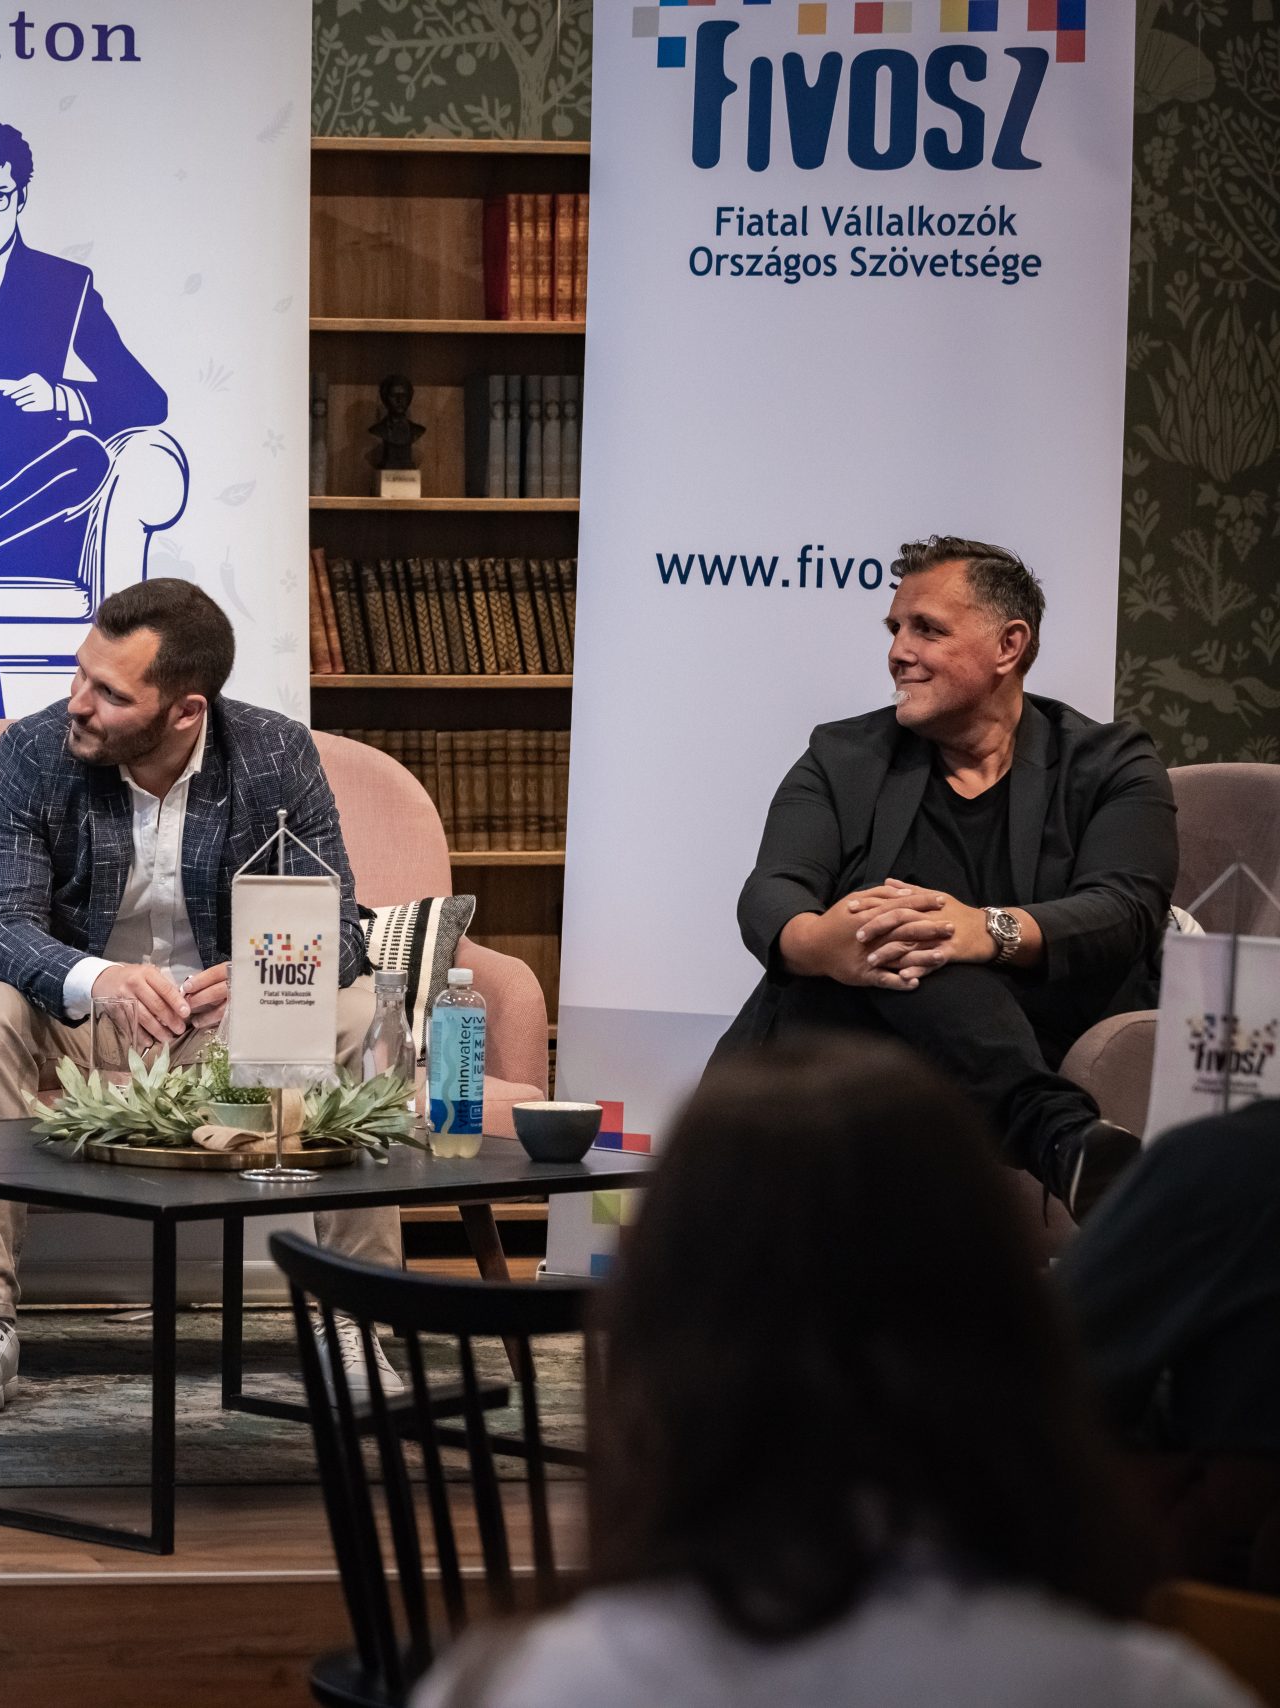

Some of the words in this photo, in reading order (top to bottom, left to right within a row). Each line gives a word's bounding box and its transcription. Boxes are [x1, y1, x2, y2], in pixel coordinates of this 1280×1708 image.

[715, 205, 808, 236] Fiatal
[821, 205, 1018, 237] Vállalkozók
[689, 246, 837, 284] Országos
[850, 246, 1042, 285] Szövetsége
[457, 1023, 471, 1128] vitaminwater
